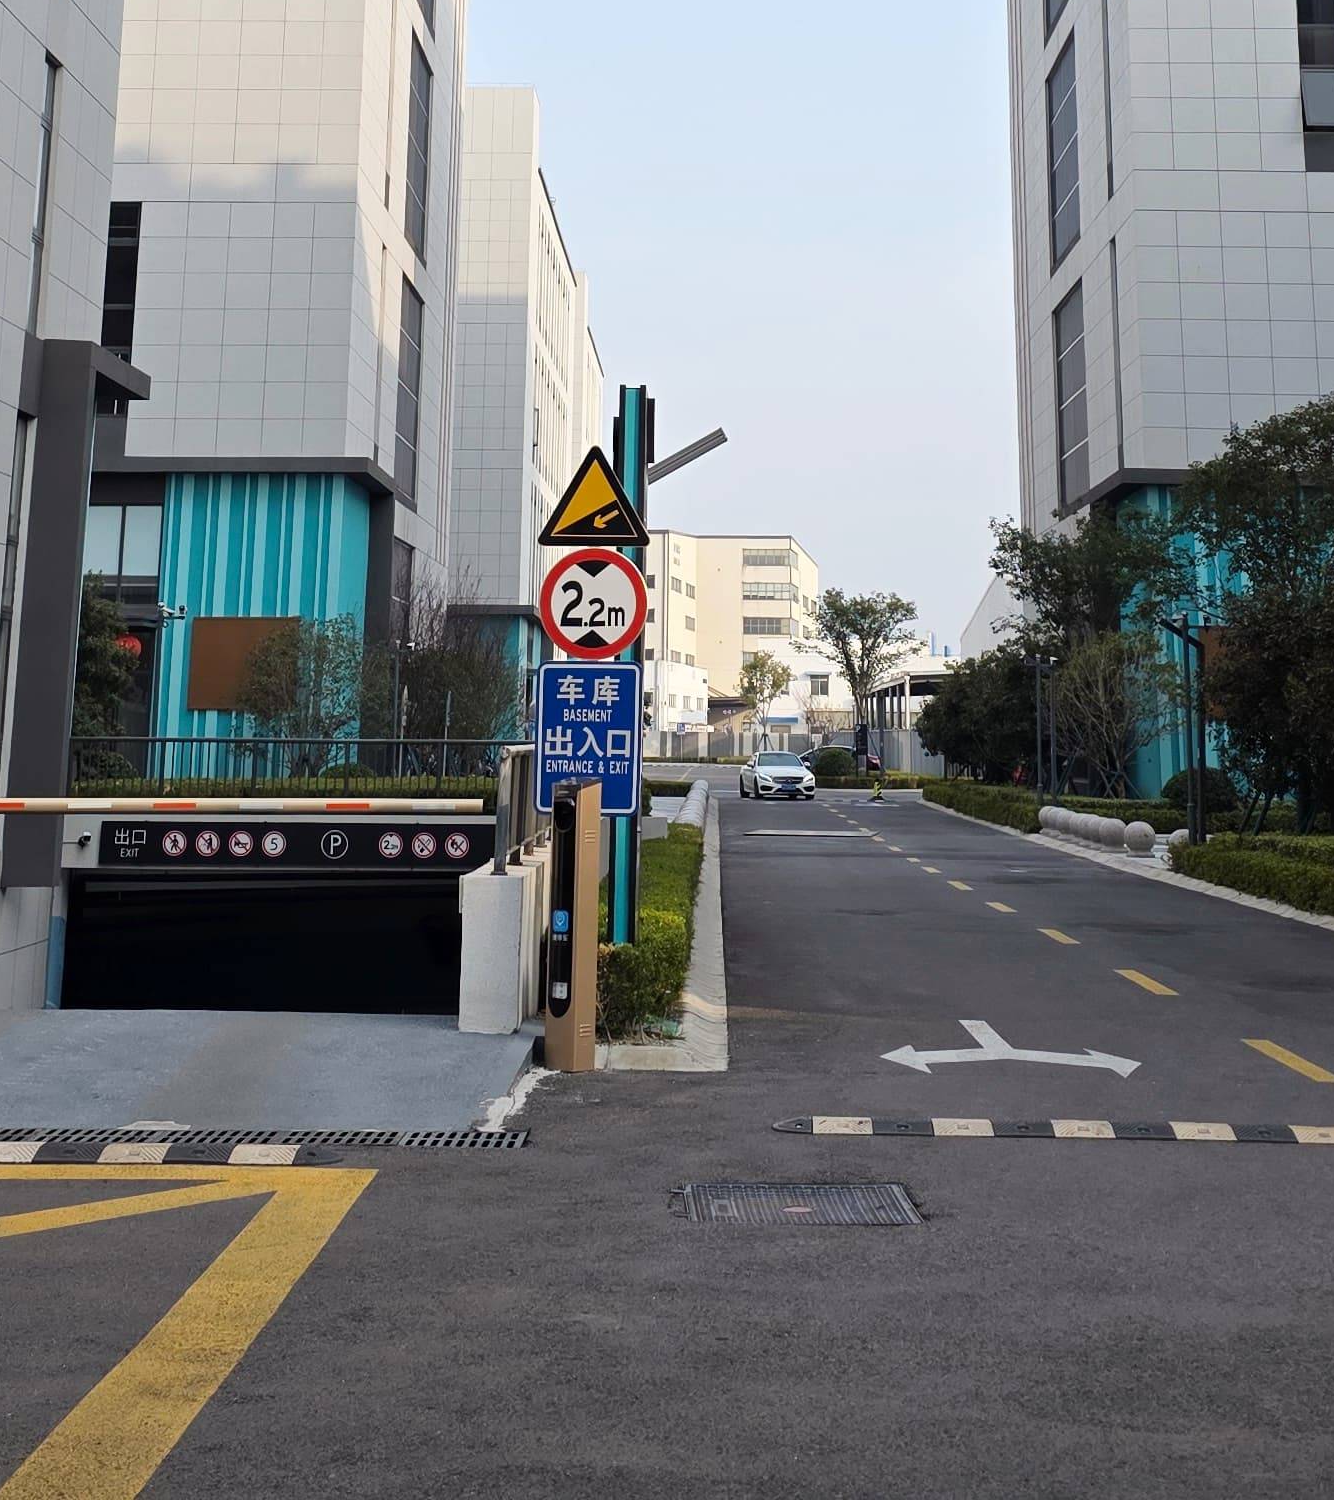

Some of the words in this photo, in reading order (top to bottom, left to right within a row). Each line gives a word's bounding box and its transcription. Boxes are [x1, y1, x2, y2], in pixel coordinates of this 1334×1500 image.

[560, 580, 626, 627] 2.2m
[556, 674, 621, 707] 车库
[563, 708, 612, 722] BASEMENT
[544, 725, 631, 758] 出入口
[545, 759, 594, 773] ENTRANCE
[597, 760, 605, 774] &
[609, 760, 630, 775] EXIT
[114, 827, 147, 845] 出口
[269, 837, 278, 851] 5
[329, 834, 342, 855] P
[120, 847, 140, 858] EXIT
